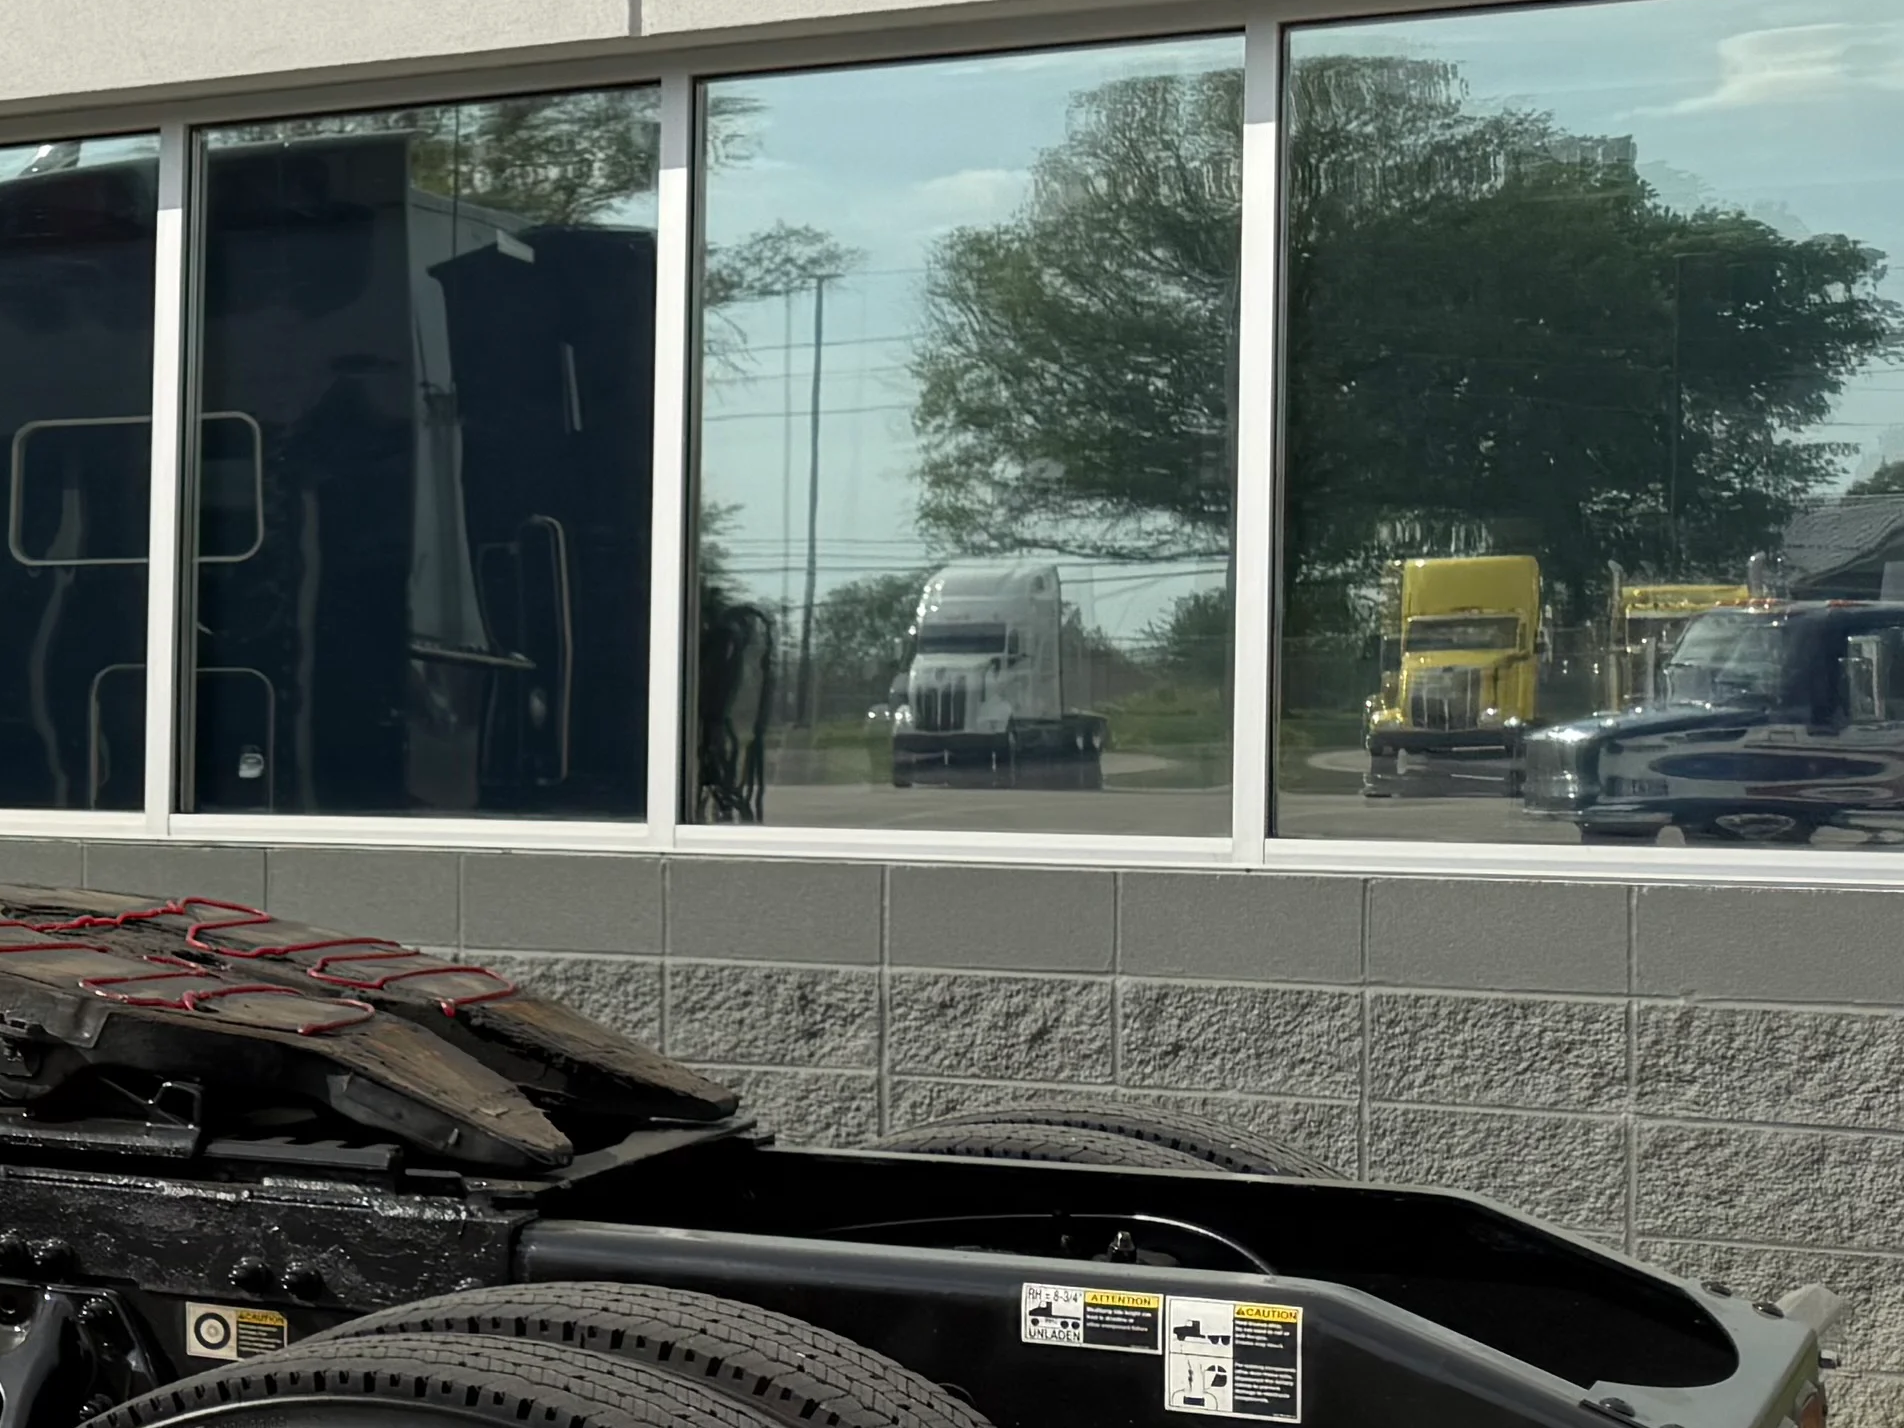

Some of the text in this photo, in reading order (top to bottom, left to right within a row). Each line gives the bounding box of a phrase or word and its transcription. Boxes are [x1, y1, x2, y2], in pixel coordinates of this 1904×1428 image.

[1028, 1288, 1042, 1300] RH
[1091, 1293, 1152, 1306] ATTENTION
[1246, 1308, 1297, 1320] CAUTION
[1028, 1327, 1081, 1342] UNLADEN
